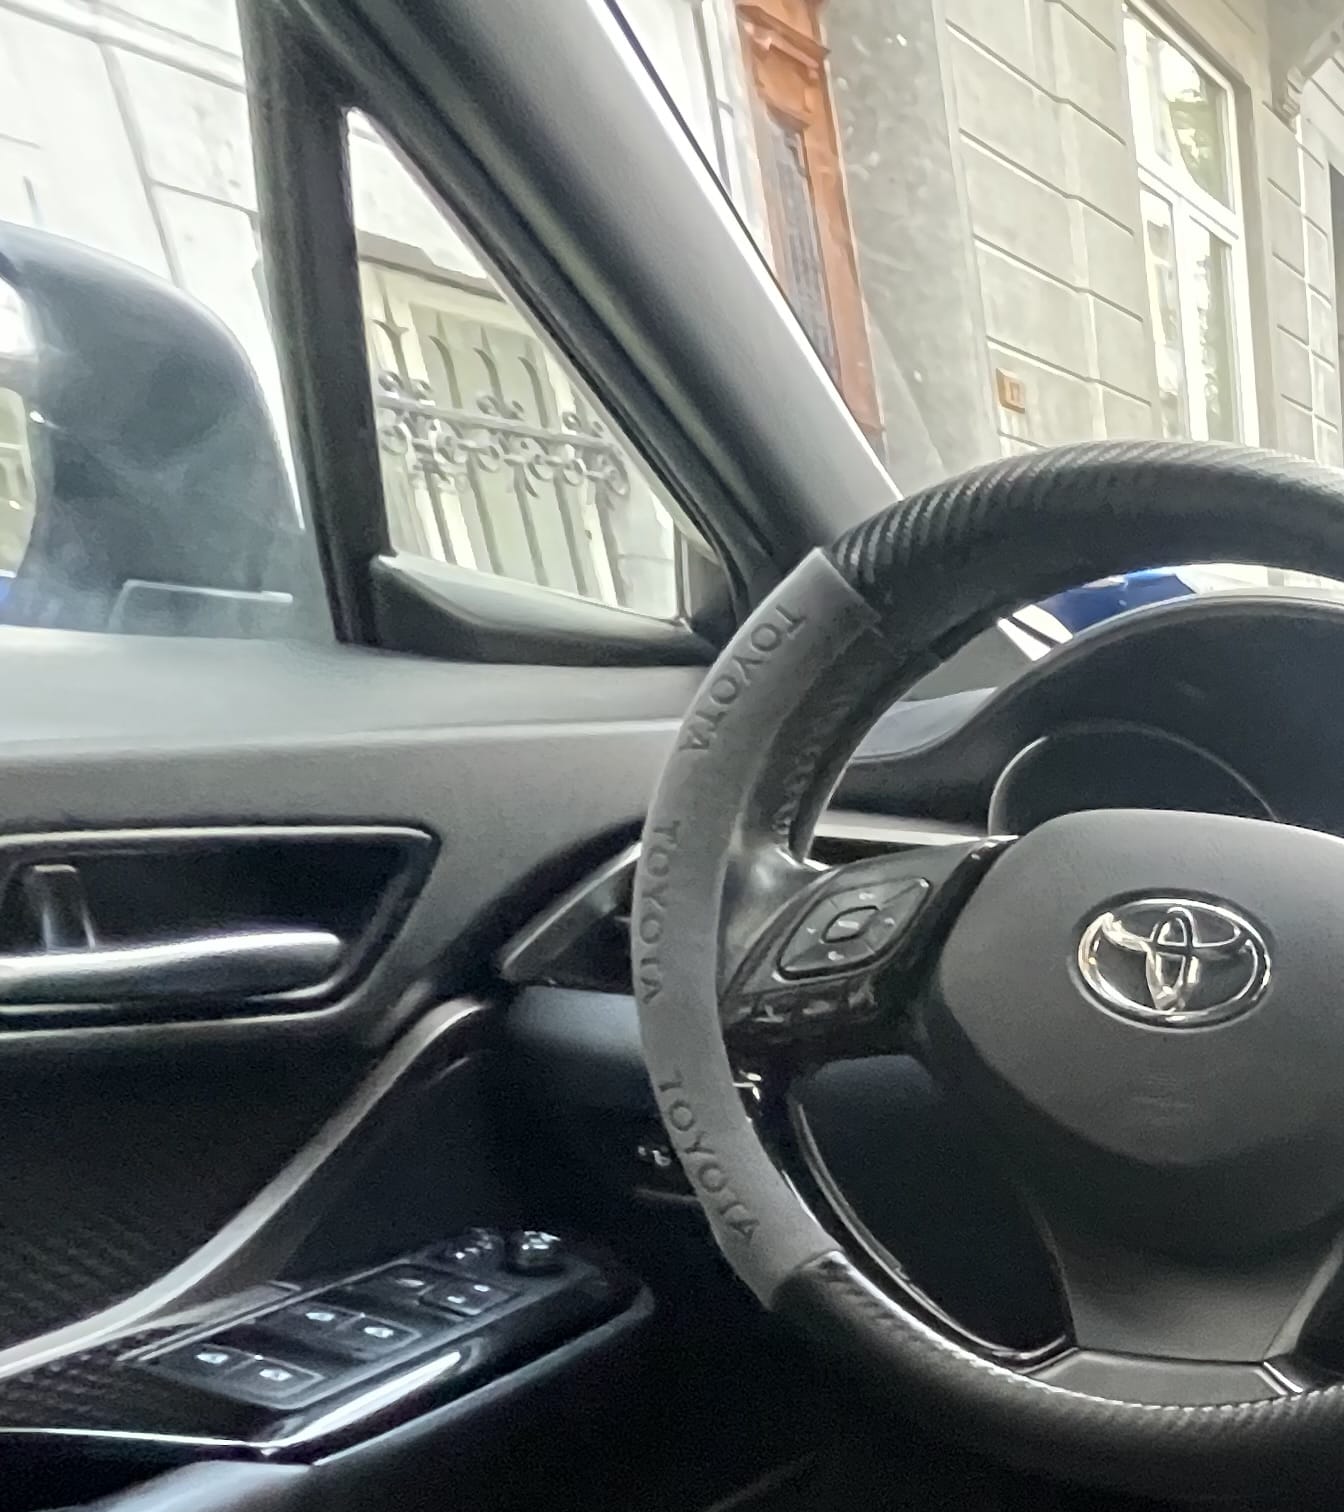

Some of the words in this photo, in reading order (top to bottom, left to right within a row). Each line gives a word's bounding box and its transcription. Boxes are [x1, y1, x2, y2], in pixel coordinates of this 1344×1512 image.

[679, 604, 806, 751] TOYOTA
[640, 820, 681, 1005] TOYOTA
[658, 1069, 760, 1237] TOYOTA
